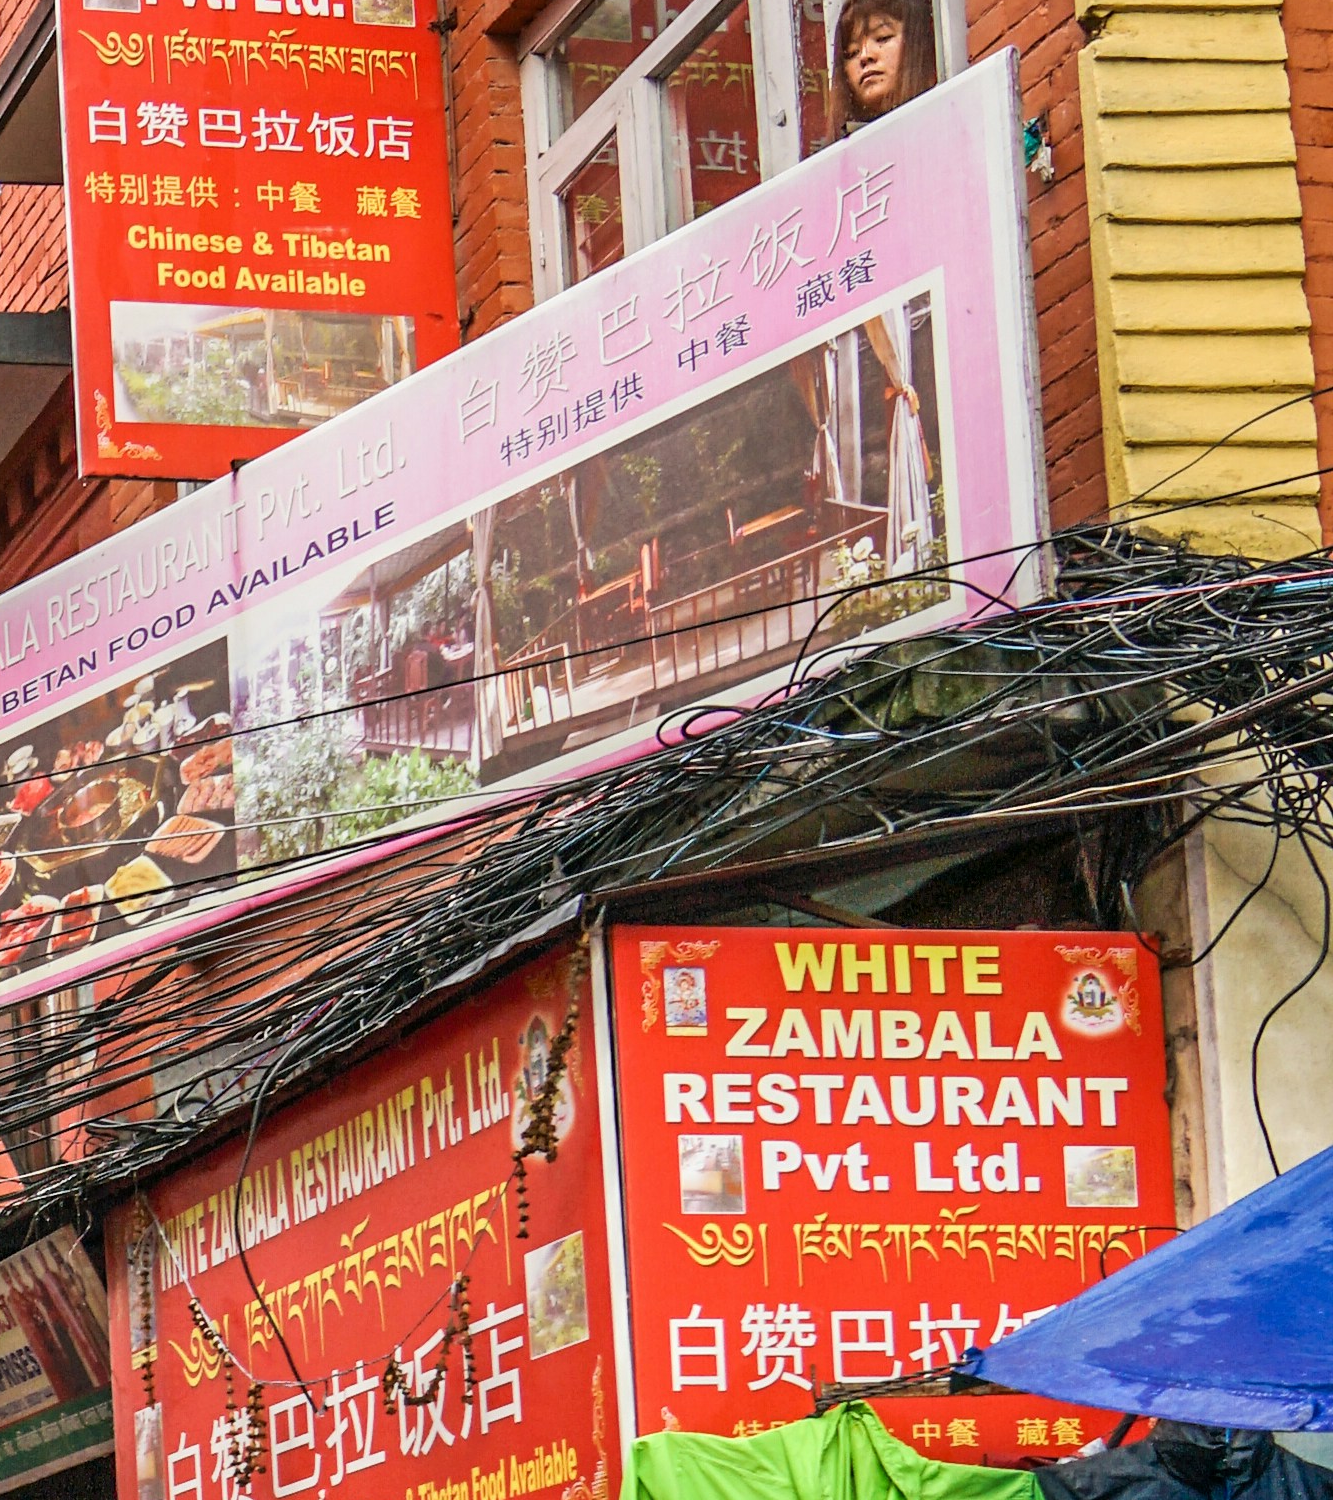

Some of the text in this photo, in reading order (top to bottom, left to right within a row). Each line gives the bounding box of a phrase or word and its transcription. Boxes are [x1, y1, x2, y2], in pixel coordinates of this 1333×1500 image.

[85, 99, 414, 161] 白赞巴拉饭店
[355, 186, 422, 220] 藏餐
[127, 225, 391, 262] Chinese & Tibetan
[157, 263, 366, 297] Food Available
[456, 161, 896, 444] 白赞巴拉饭店
[500, 249, 877, 466] 特别提供 中餐 藏餐
[47, 500, 244, 647] RESTAURANT
[257, 472, 322, 541] Pvt.
[337, 420, 406, 500] Ltd.
[107, 602, 196, 663] FOOD
[206, 501, 395, 617] AVAILABLE
[774, 942, 1003, 994] WHITE
[725, 1008, 1062, 1060] ZAMBALA
[663, 1073, 1128, 1126] RESTAURANT
[159, 1037, 510, 1291] WHITE ZAMBALA RESTAURANT Pvt. Ltd.
[760, 1140, 1041, 1193] Pvt. Ltd.
[1016, 1418, 1084, 1446] 藏餐
